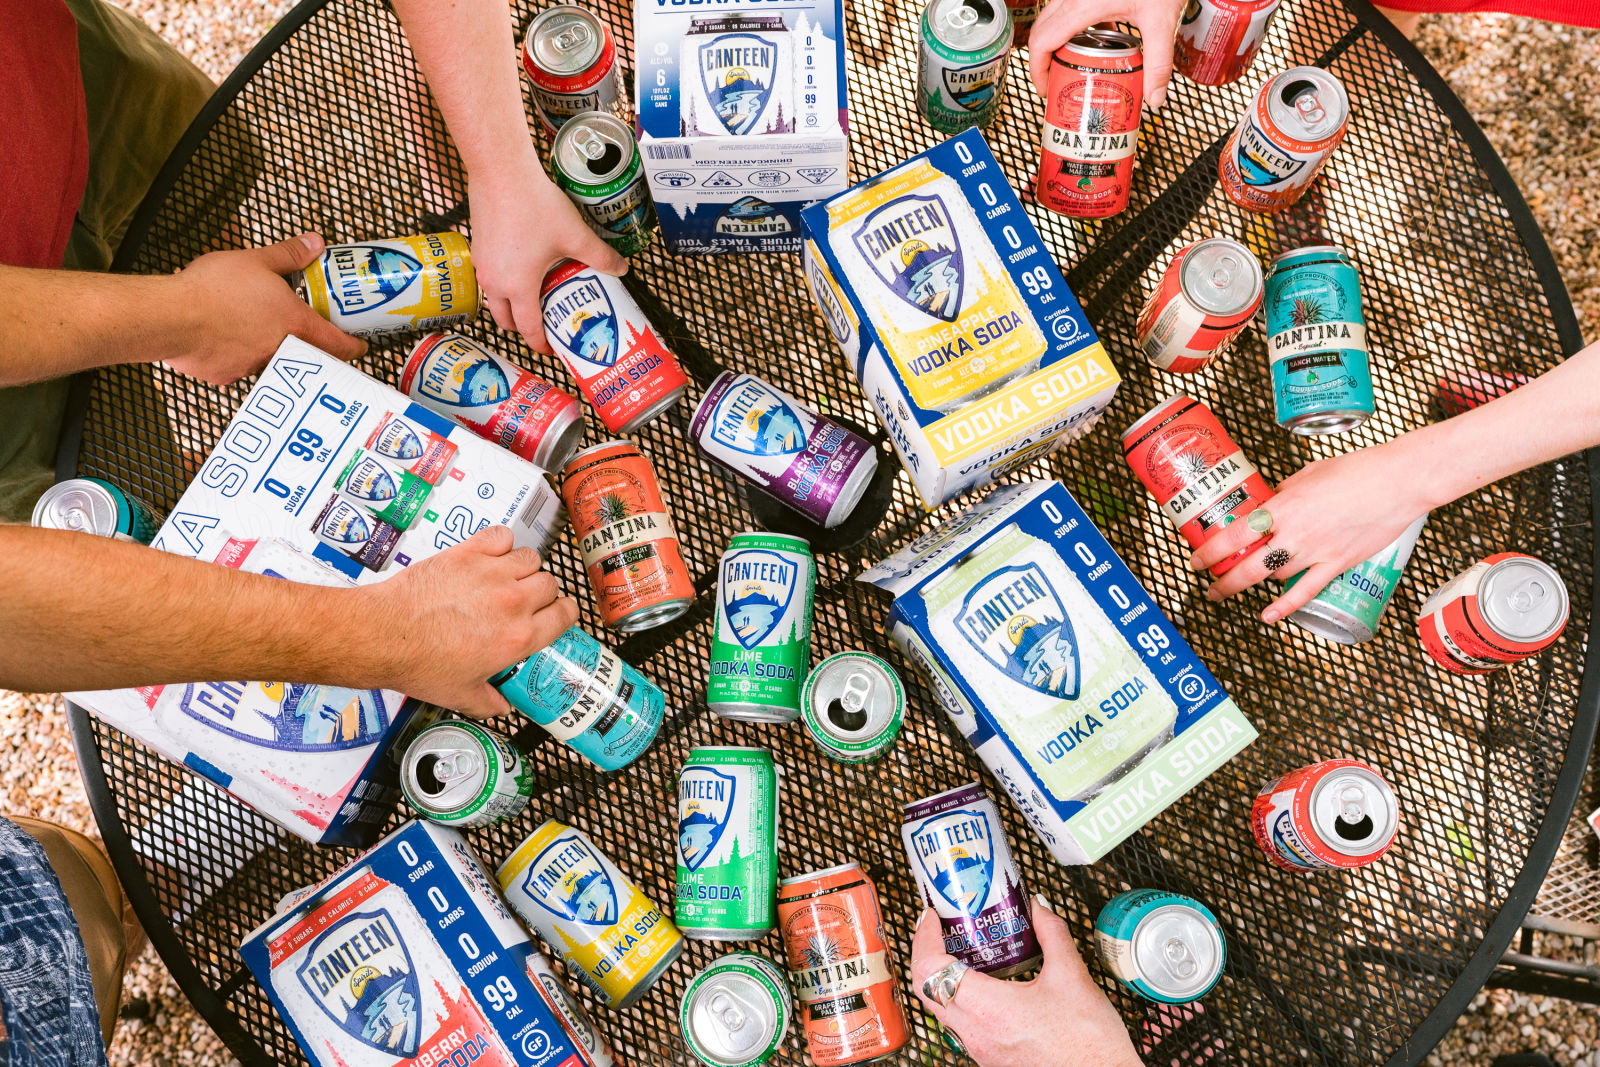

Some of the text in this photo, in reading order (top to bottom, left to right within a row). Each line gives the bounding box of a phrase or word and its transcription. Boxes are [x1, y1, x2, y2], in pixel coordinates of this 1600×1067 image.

[807, 36, 811, 46] 0
[707, 48, 769, 70] CANTEEN
[807, 56, 812, 65] 0
[657, 70, 666, 86] 6
[808, 75, 812, 84] 0
[805, 94, 816, 104] 99
[1052, 129, 1128, 151] CANTINA
[1245, 125, 1294, 171] CANTEEN
[954, 141, 973, 164] 0
[962, 160, 987, 177] SUGAR
[1067, 162, 1111, 170] WATERMELON
[978, 182, 997, 206] 0
[1058, 185, 1112, 199] TEQUILA SODA
[986, 203, 1011, 220] CARBS
[722, 222, 786, 232] CANTEEN
[864, 203, 945, 260] CANTEEN
[1002, 225, 1021, 249] 0
[678, 238, 702, 246] YOU
[737, 244, 802, 252] WHEREVER
[904, 242, 923, 256] Spirits
[1008, 245, 1038, 264] SODIUM
[335, 250, 365, 306] CANTEEN
[438, 261, 453, 311] VODKA
[1021, 266, 1053, 296] 99
[545, 282, 600, 329] CANTEEN
[815, 269, 847, 332] CANTEEN
[1040, 292, 1056, 304] CAL
[1044, 306, 1070, 322] Certified
[917, 305, 999, 351] PINEAPPLE
[1058, 321, 1072, 334] GF
[1275, 323, 1351, 350] CANTINA
[907, 310, 1024, 377] VODKA SODA
[1056, 331, 1090, 351] Gluten-Free
[425, 341, 473, 394] CANTEEN
[590, 347, 648, 394] STRAWBERRY
[1290, 354, 1337, 369] RANCH WATER
[592, 354, 664, 408] VODKA SODA
[1321, 378, 1343, 389] SODA
[319, 394, 346, 414] 0
[340, 400, 363, 427] CARBS
[493, 377, 540, 436] WATERMELON
[718, 385, 766, 442] CANTEEN
[933, 399, 1028, 452] VODKA
[1030, 358, 1108, 407] SODA
[201, 358, 322, 497] SODA
[379, 424, 403, 453] CANTEEN
[500, 404, 532, 450] VODKA
[990, 412, 1068, 453] PINEAPPLE
[288, 428, 323, 462] 99
[432, 440, 447, 458] SODA
[959, 406, 1097, 475] VODKA SODA
[316, 447, 332, 463] CAL
[787, 423, 835, 490] BLACK CHERRY
[264, 478, 290, 498] 0
[350, 461, 376, 494] CANTEEN
[405, 480, 422, 499] SODA
[794, 454, 829, 501] VODKA
[1170, 458, 1241, 513] CANTINA
[284, 485, 307, 513] SUGAR
[394, 491, 405, 507] LIME
[481, 486, 490, 496] GF
[506, 502, 518, 518] CANS
[1040, 500, 1063, 524] 0
[1202, 490, 1241, 521] WATERMELON
[1206, 498, 1242, 524] MARGARITA
[325, 505, 350, 536] CANTEEN
[1054, 518, 1079, 539] SUGAR
[583, 515, 657, 553] CANTINA
[607, 546, 648, 565] GRAPEFRUIT
[614, 553, 644, 568] PALOMA
[920, 550, 952, 575] MINT
[1074, 541, 1097, 567] 0
[609, 571, 663, 594] TEQUILA SODA
[727, 562, 788, 585] CANTEEN
[1087, 560, 1113, 582] CARBS
[1366, 567, 1390, 589] MINT
[1108, 584, 1131, 610] 0
[1350, 573, 1384, 603] SODA
[965, 573, 1047, 644] CANTEEN
[1119, 602, 1149, 626] SODIUM
[1010, 618, 1029, 634] Spirits
[1136, 624, 1170, 658] 99
[733, 651, 763, 662] LIME
[1160, 651, 1177, 666] CAL
[754, 663, 795, 681] SODA
[912, 646, 957, 708] CANTEEN
[1168, 664, 1194, 685] Certified
[559, 654, 615, 728] CANTINA
[1184, 680, 1199, 695] GF
[1188, 688, 1219, 715] Gluten-Free
[600, 703, 619, 730] RANCH
[1036, 676, 1149, 765] VODKA SODA
[1079, 716, 1244, 844] VODKA SODA
[940, 800, 959, 810] CALORIES
[397, 840, 419, 867] 0
[408, 860, 435, 883] SUGAR
[531, 842, 588, 899] CANTEEN
[682, 874, 705, 884] LIME
[427, 886, 449, 913] 0
[698, 886, 742, 901] SODA
[1136, 893, 1190, 908] CANTINA
[293, 880, 379, 945] SUGARS CALORIES CARBS
[438, 906, 466, 929] CARBS
[976, 905, 1019, 930] CHERRY
[991, 918, 1030, 941] SODA
[458, 933, 480, 960] 0
[591, 908, 663, 979] VODKA SODA
[308, 919, 394, 998] CANTEEN
[467, 952, 498, 978] SODIUM
[353, 968, 374, 988] Spirits
[793, 959, 870, 989] CANTINA
[483, 976, 518, 1012] 99
[814, 996, 857, 1012] GRAPEFRUIT
[505, 1005, 524, 1020] CAL
[545, 980, 590, 1045] CANTEEN
[820, 1005, 851, 1017] PALOMA
[511, 1018, 540, 1041] Certified
[850, 1023, 872, 1039] SODA
[527, 1036, 544, 1052] GF
